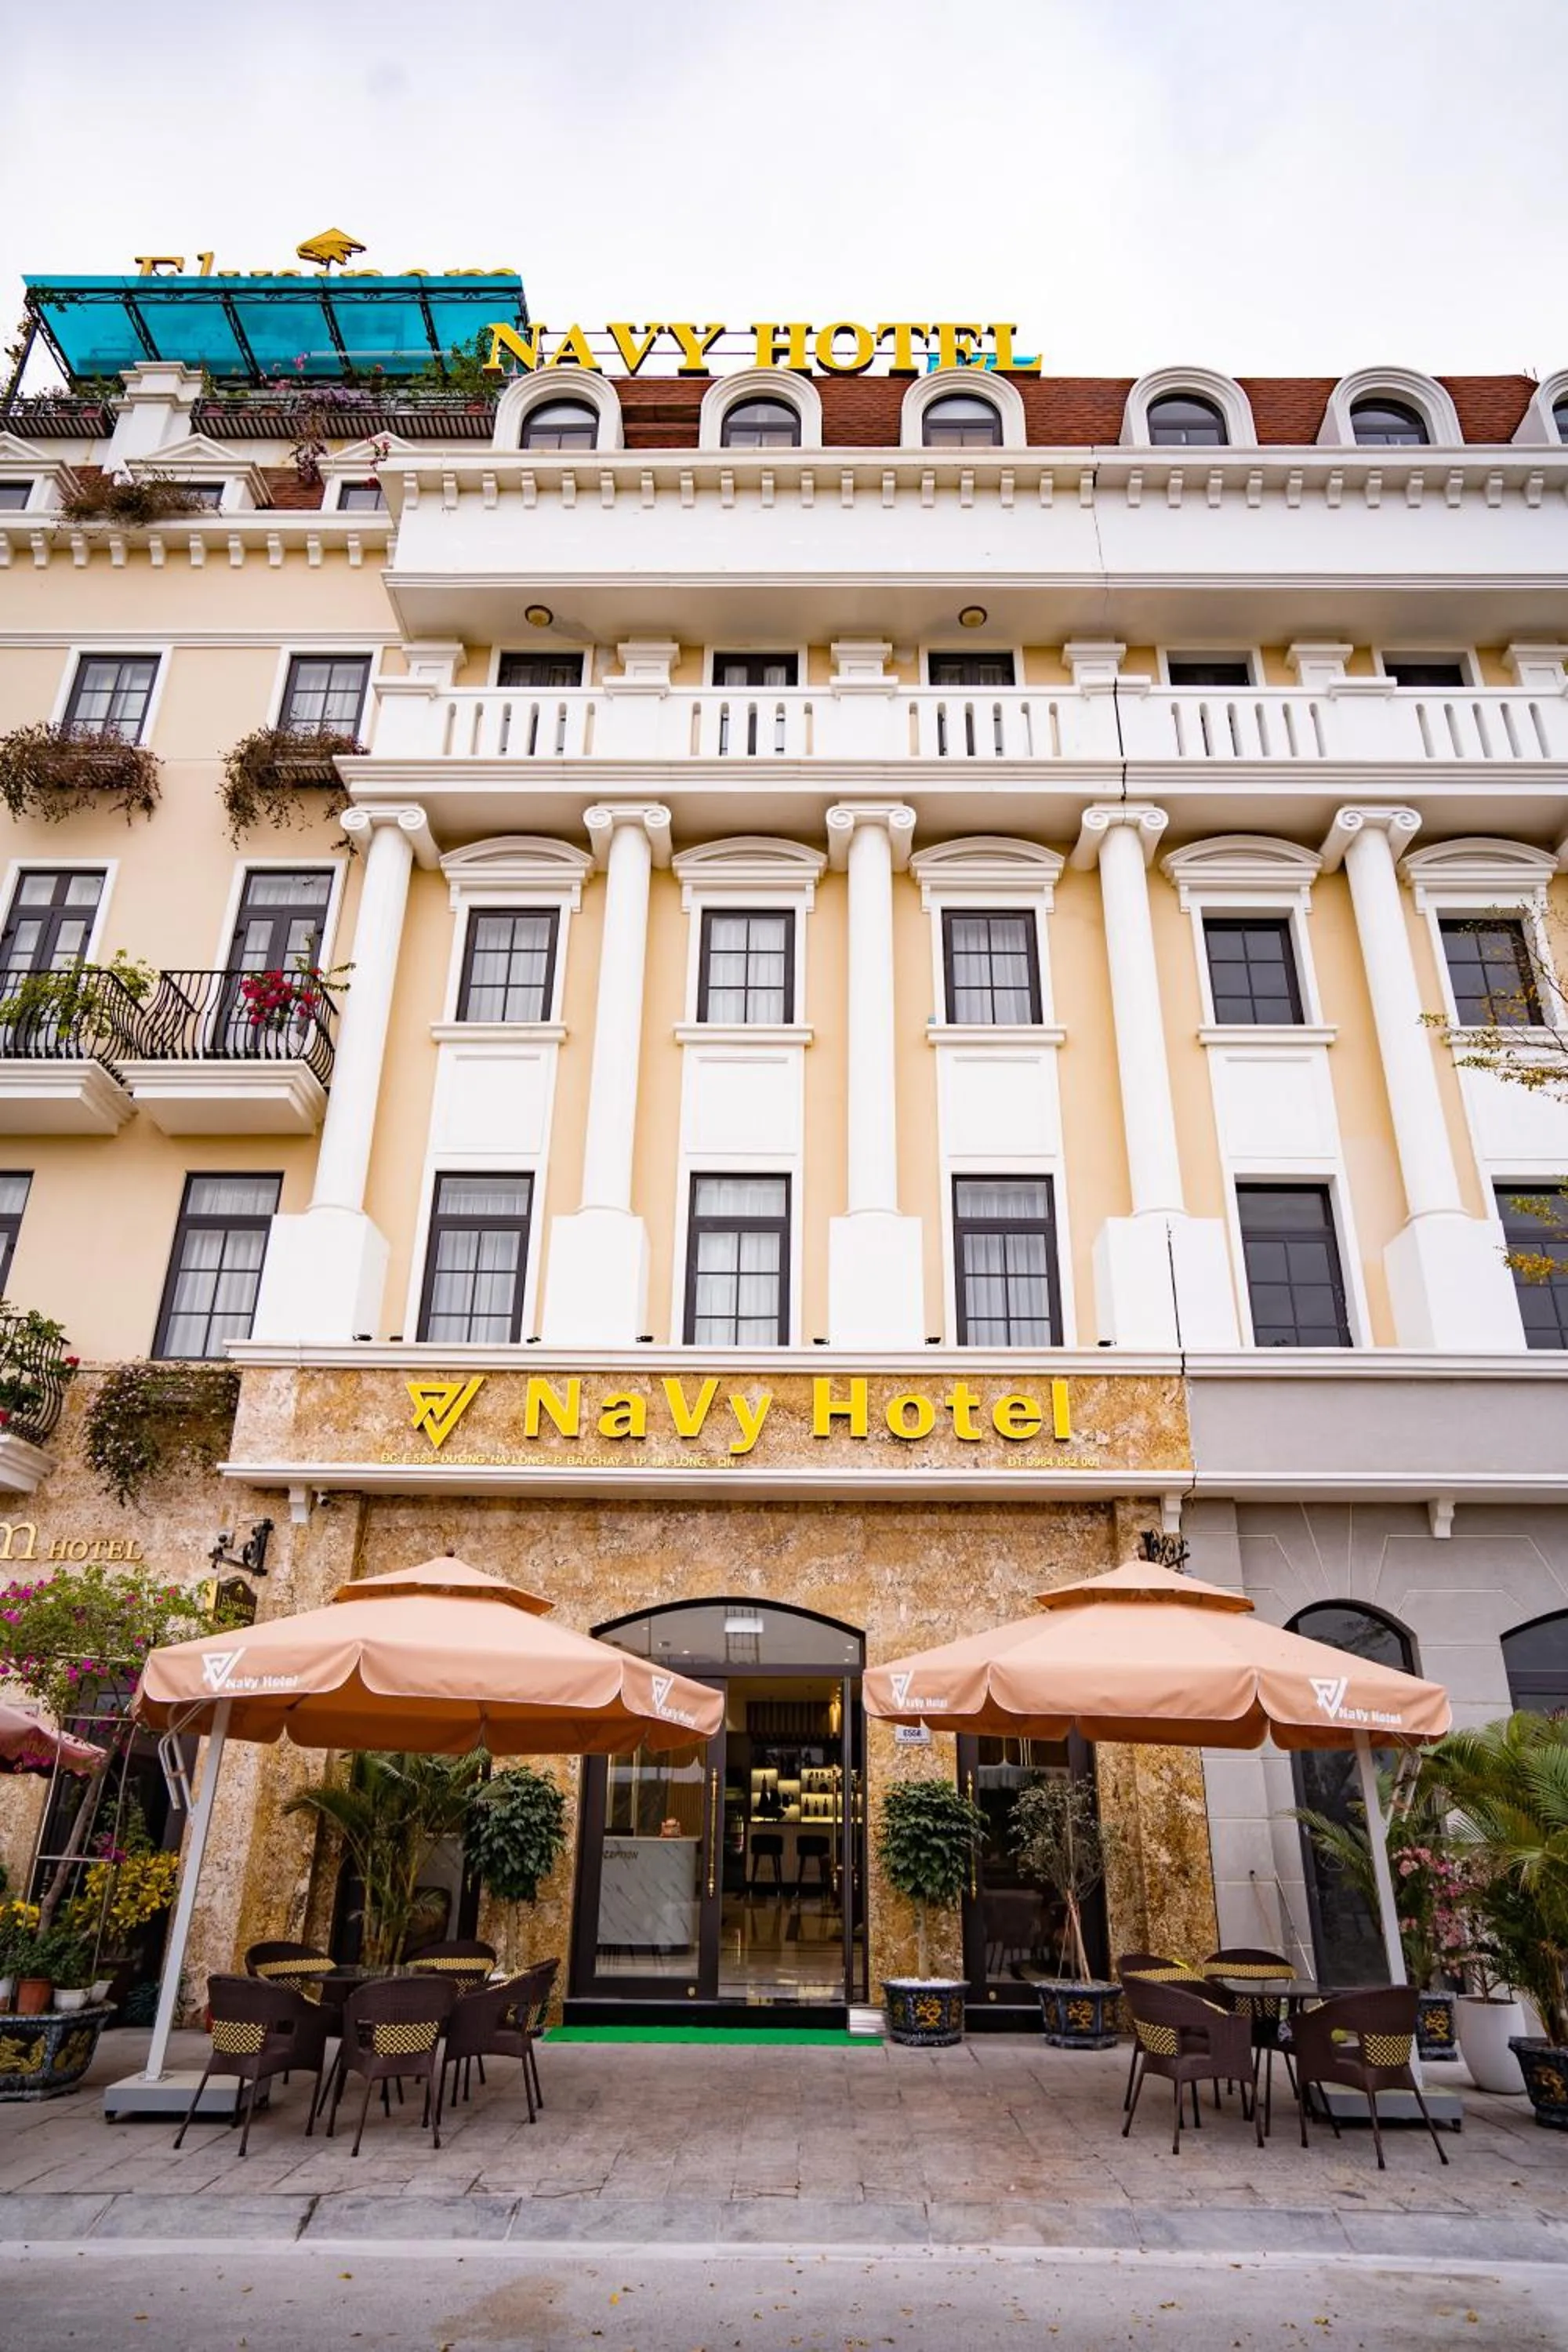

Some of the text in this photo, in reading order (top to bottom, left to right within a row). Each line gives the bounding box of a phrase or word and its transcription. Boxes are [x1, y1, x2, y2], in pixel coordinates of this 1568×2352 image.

[481, 321, 1043, 377] NAVY HOTEL
[523, 1377, 1073, 1455] NaVy Hotel
[47, 1538, 144, 1562] HOTEL
[263, 1675, 299, 1688] Hotel
